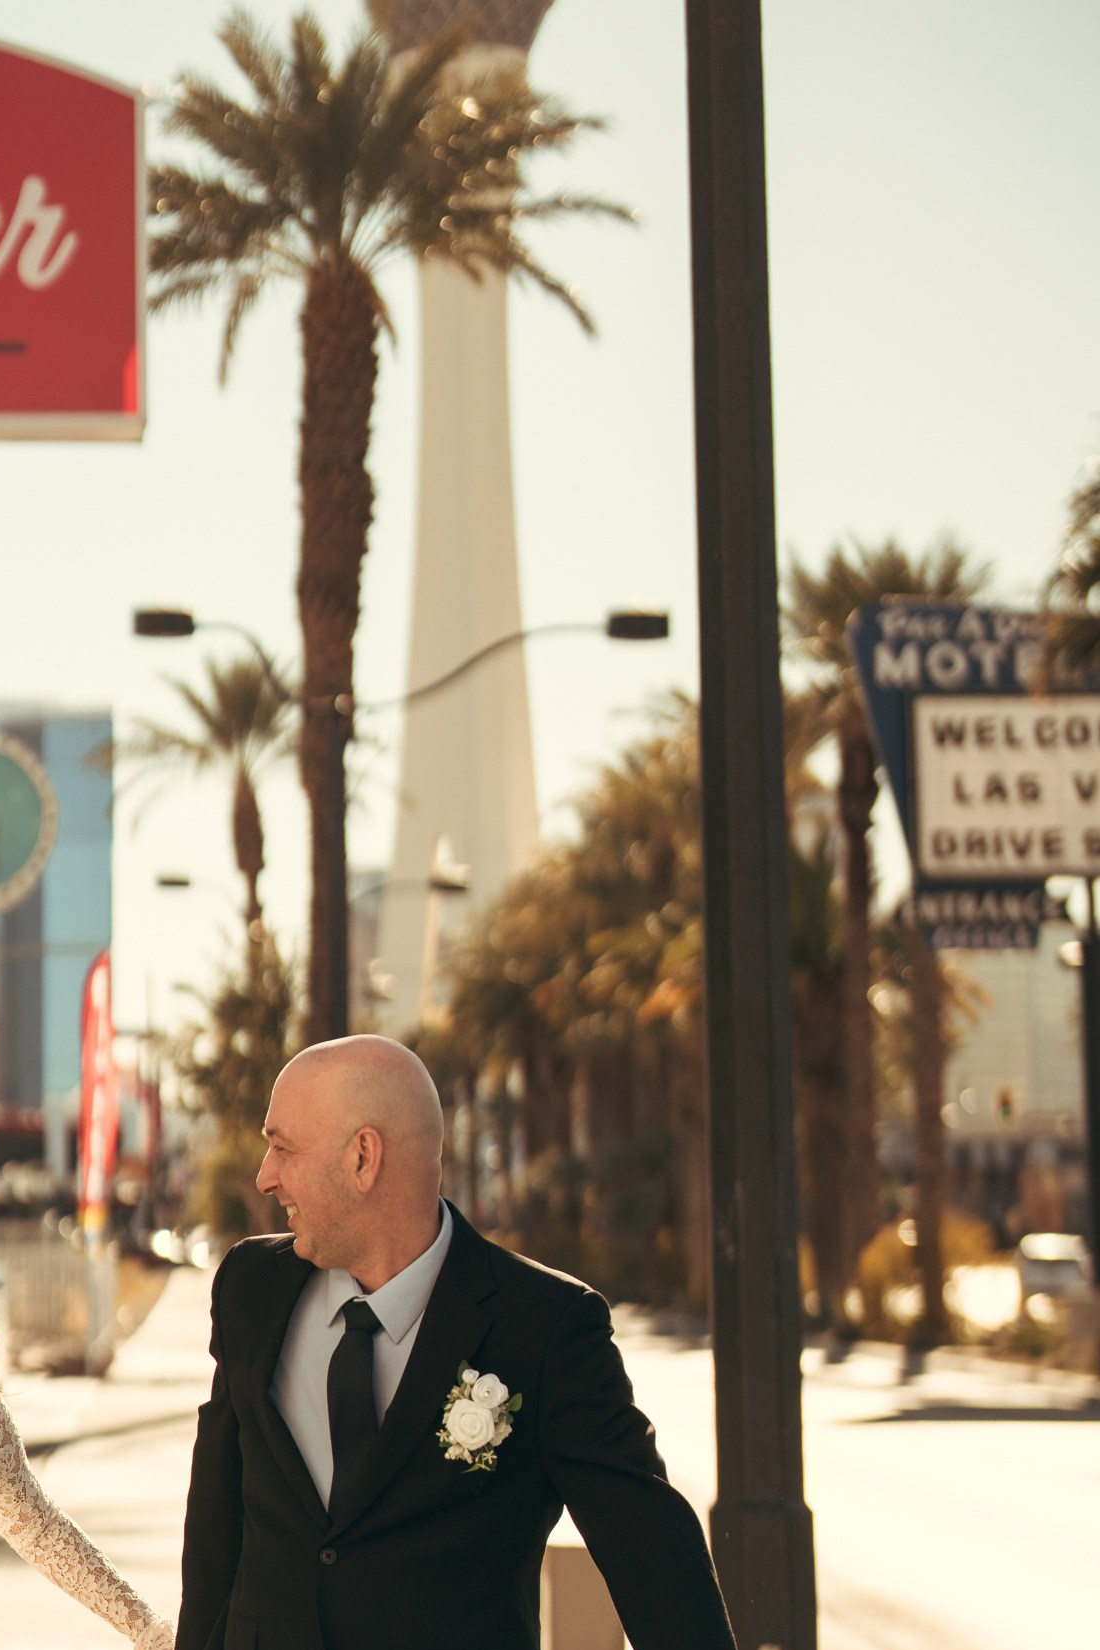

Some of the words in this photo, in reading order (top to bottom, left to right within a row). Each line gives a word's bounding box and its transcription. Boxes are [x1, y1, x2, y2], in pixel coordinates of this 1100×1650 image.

[873, 640, 1080, 689] MOTE
[931, 715, 1100, 750] WELCO
[954, 769, 1042, 805] LAS
[931, 826, 1064, 860] DRIVE
